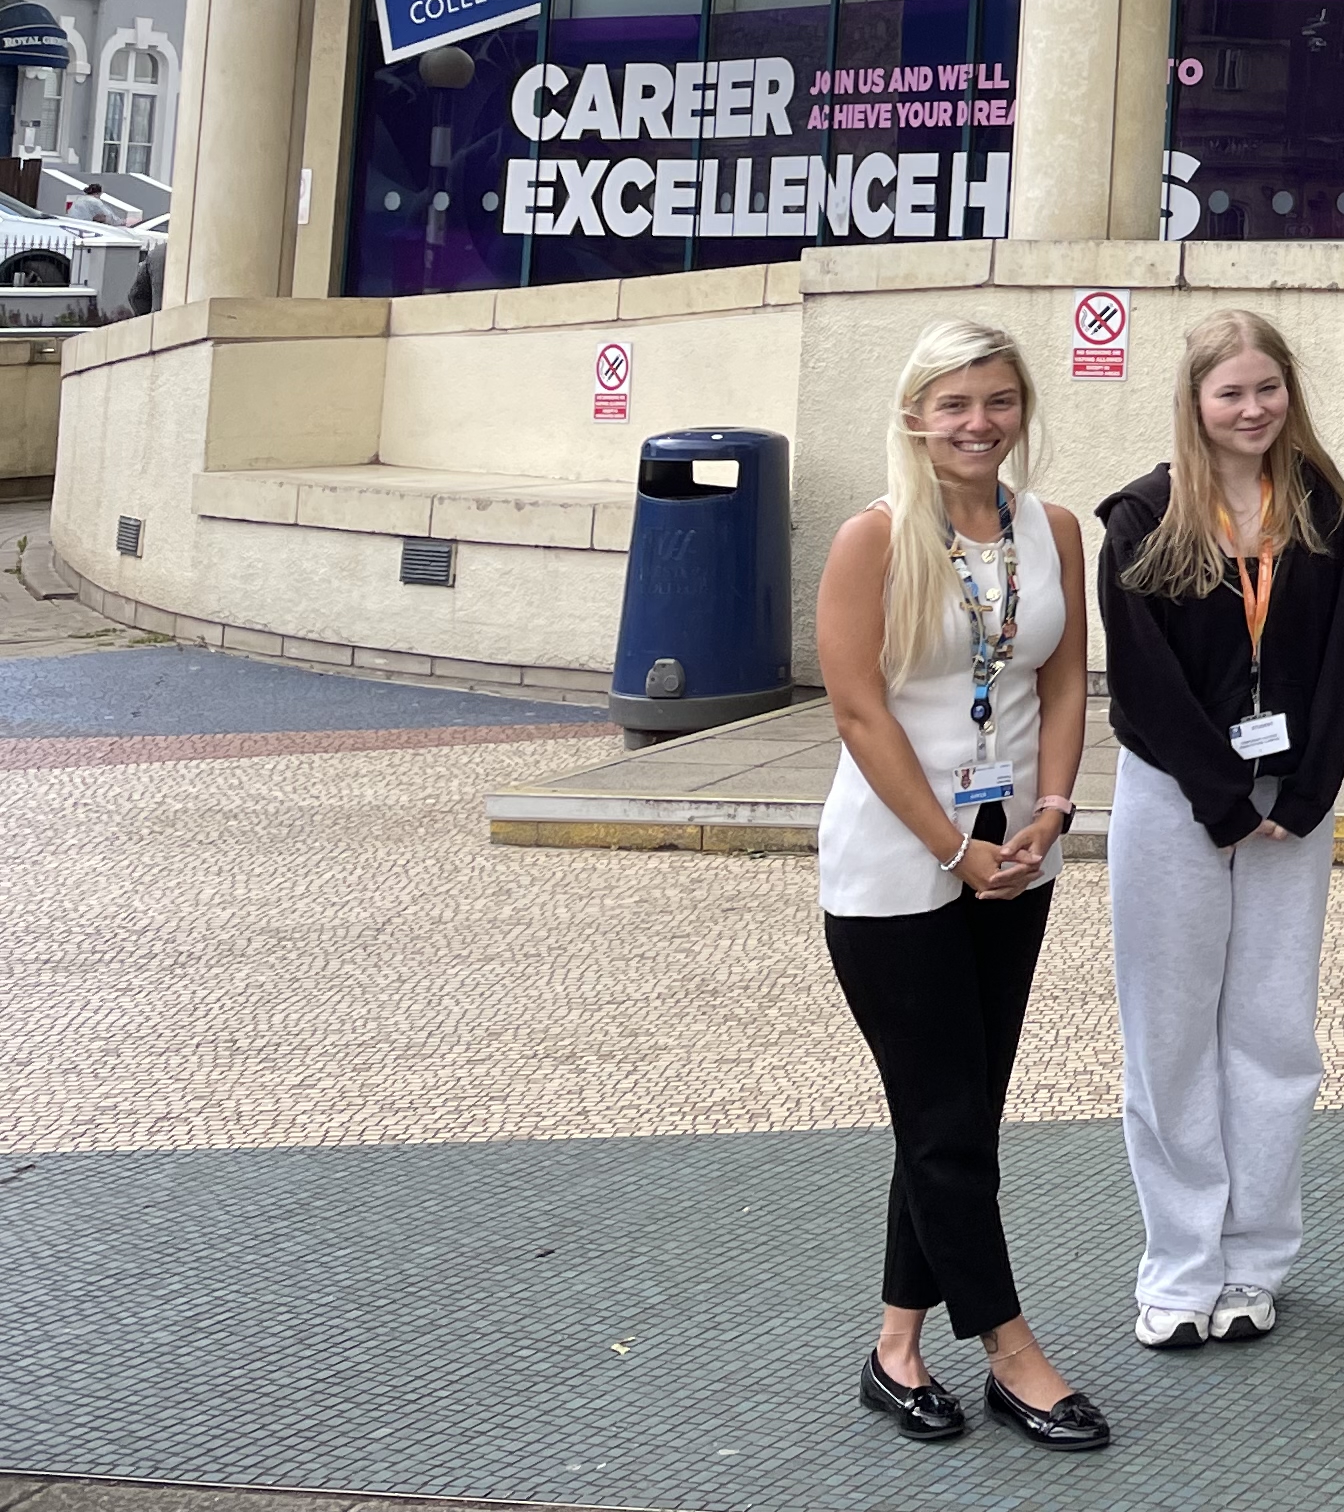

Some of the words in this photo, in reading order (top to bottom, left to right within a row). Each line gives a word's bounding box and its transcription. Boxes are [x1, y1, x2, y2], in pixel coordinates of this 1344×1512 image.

[2, 35, 42, 48] ROYAL
[809, 68, 854, 96] JOIN
[858, 67, 885, 94] US
[888, 64, 933, 94] AND
[937, 63, 1010, 91] WE'LL
[511, 56, 795, 142] CAREER
[806, 102, 893, 131] ACHIEVE
[896, 100, 953, 128] YOUR
[502, 152, 939, 238] EXCELLENCE
